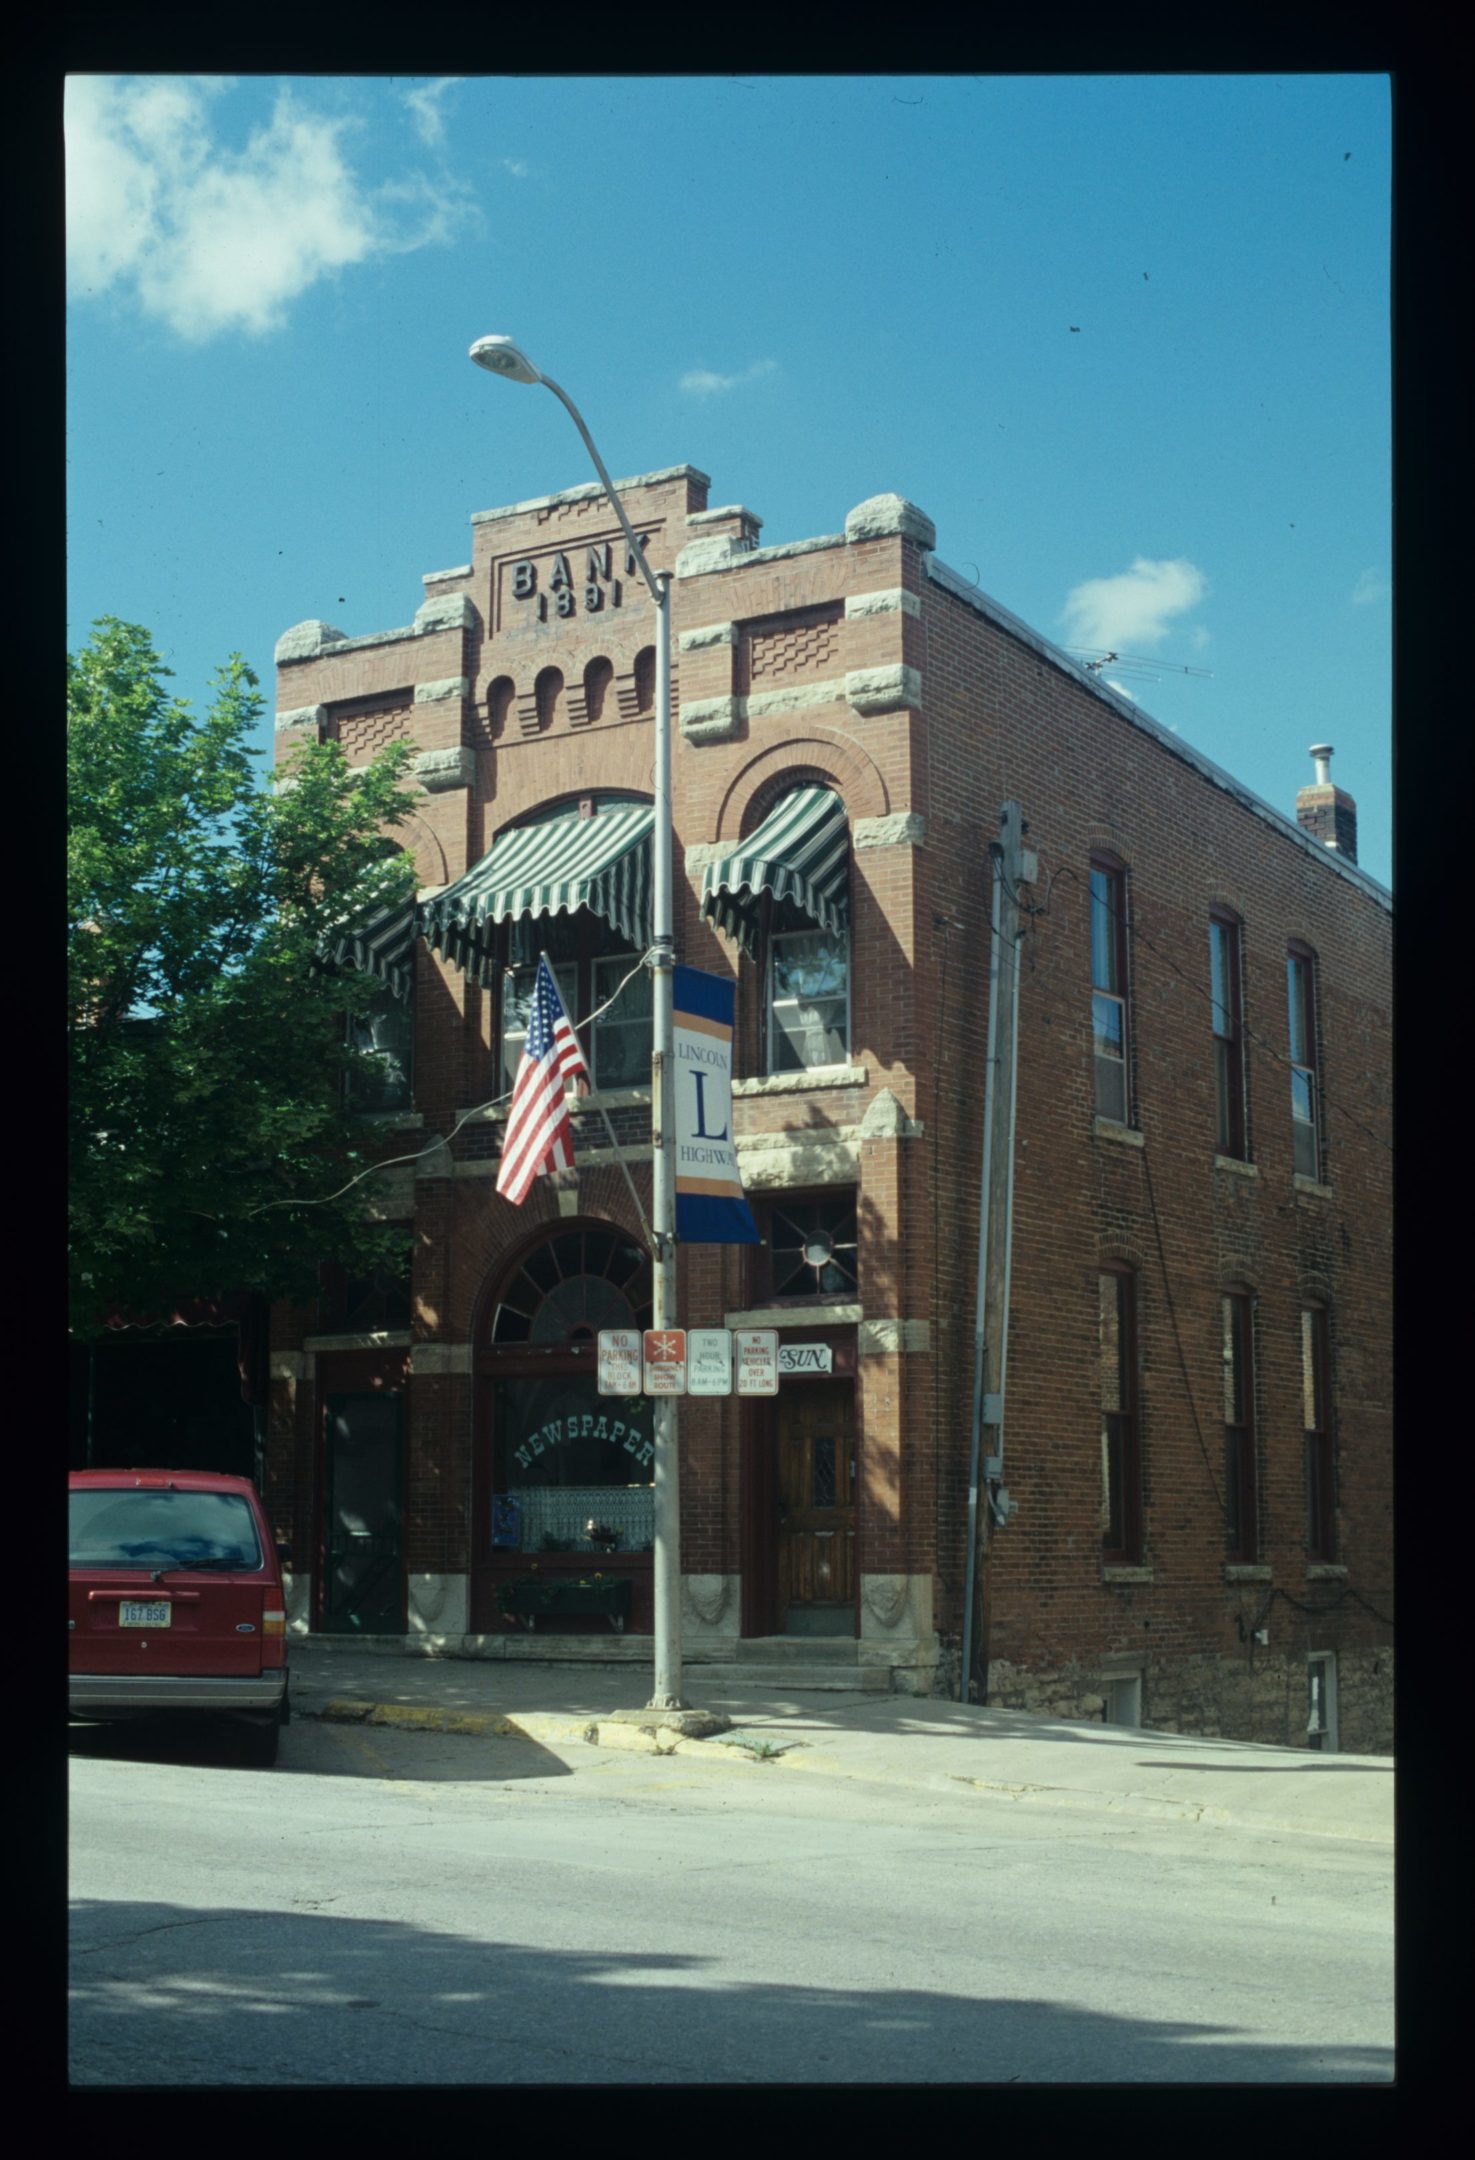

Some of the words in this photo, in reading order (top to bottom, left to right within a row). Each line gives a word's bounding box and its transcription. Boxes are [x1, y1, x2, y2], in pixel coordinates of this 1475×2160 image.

[511, 533, 649, 597] BANK
[536, 578, 620, 622] 1891
[678, 1042, 728, 1070] LINCOLN
[688, 1069, 729, 1142] L
[680, 1145, 737, 1167] HIGHWA
[611, 1335, 628, 1347] NO
[702, 1338, 718, 1346] TWO
[752, 1336, 761, 1344] NO
[601, 1349, 638, 1360] PARKING
[699, 1352, 720, 1360] HOUR
[744, 1346, 769, 1355] PARKING
[780, 1348, 827, 1370] SUN
[693, 1364, 725, 1373] PARKING
[748, 1368, 765, 1376] OVER
[608, 1371, 631, 1380] BLOCK
[654, 1382, 676, 1390] ROUTE
[749, 1378, 757, 1387] FT
[758, 1378, 773, 1387] LONG
[514, 1414, 656, 1469] NEWSPAPER
[125, 1607, 144, 1621] 167
